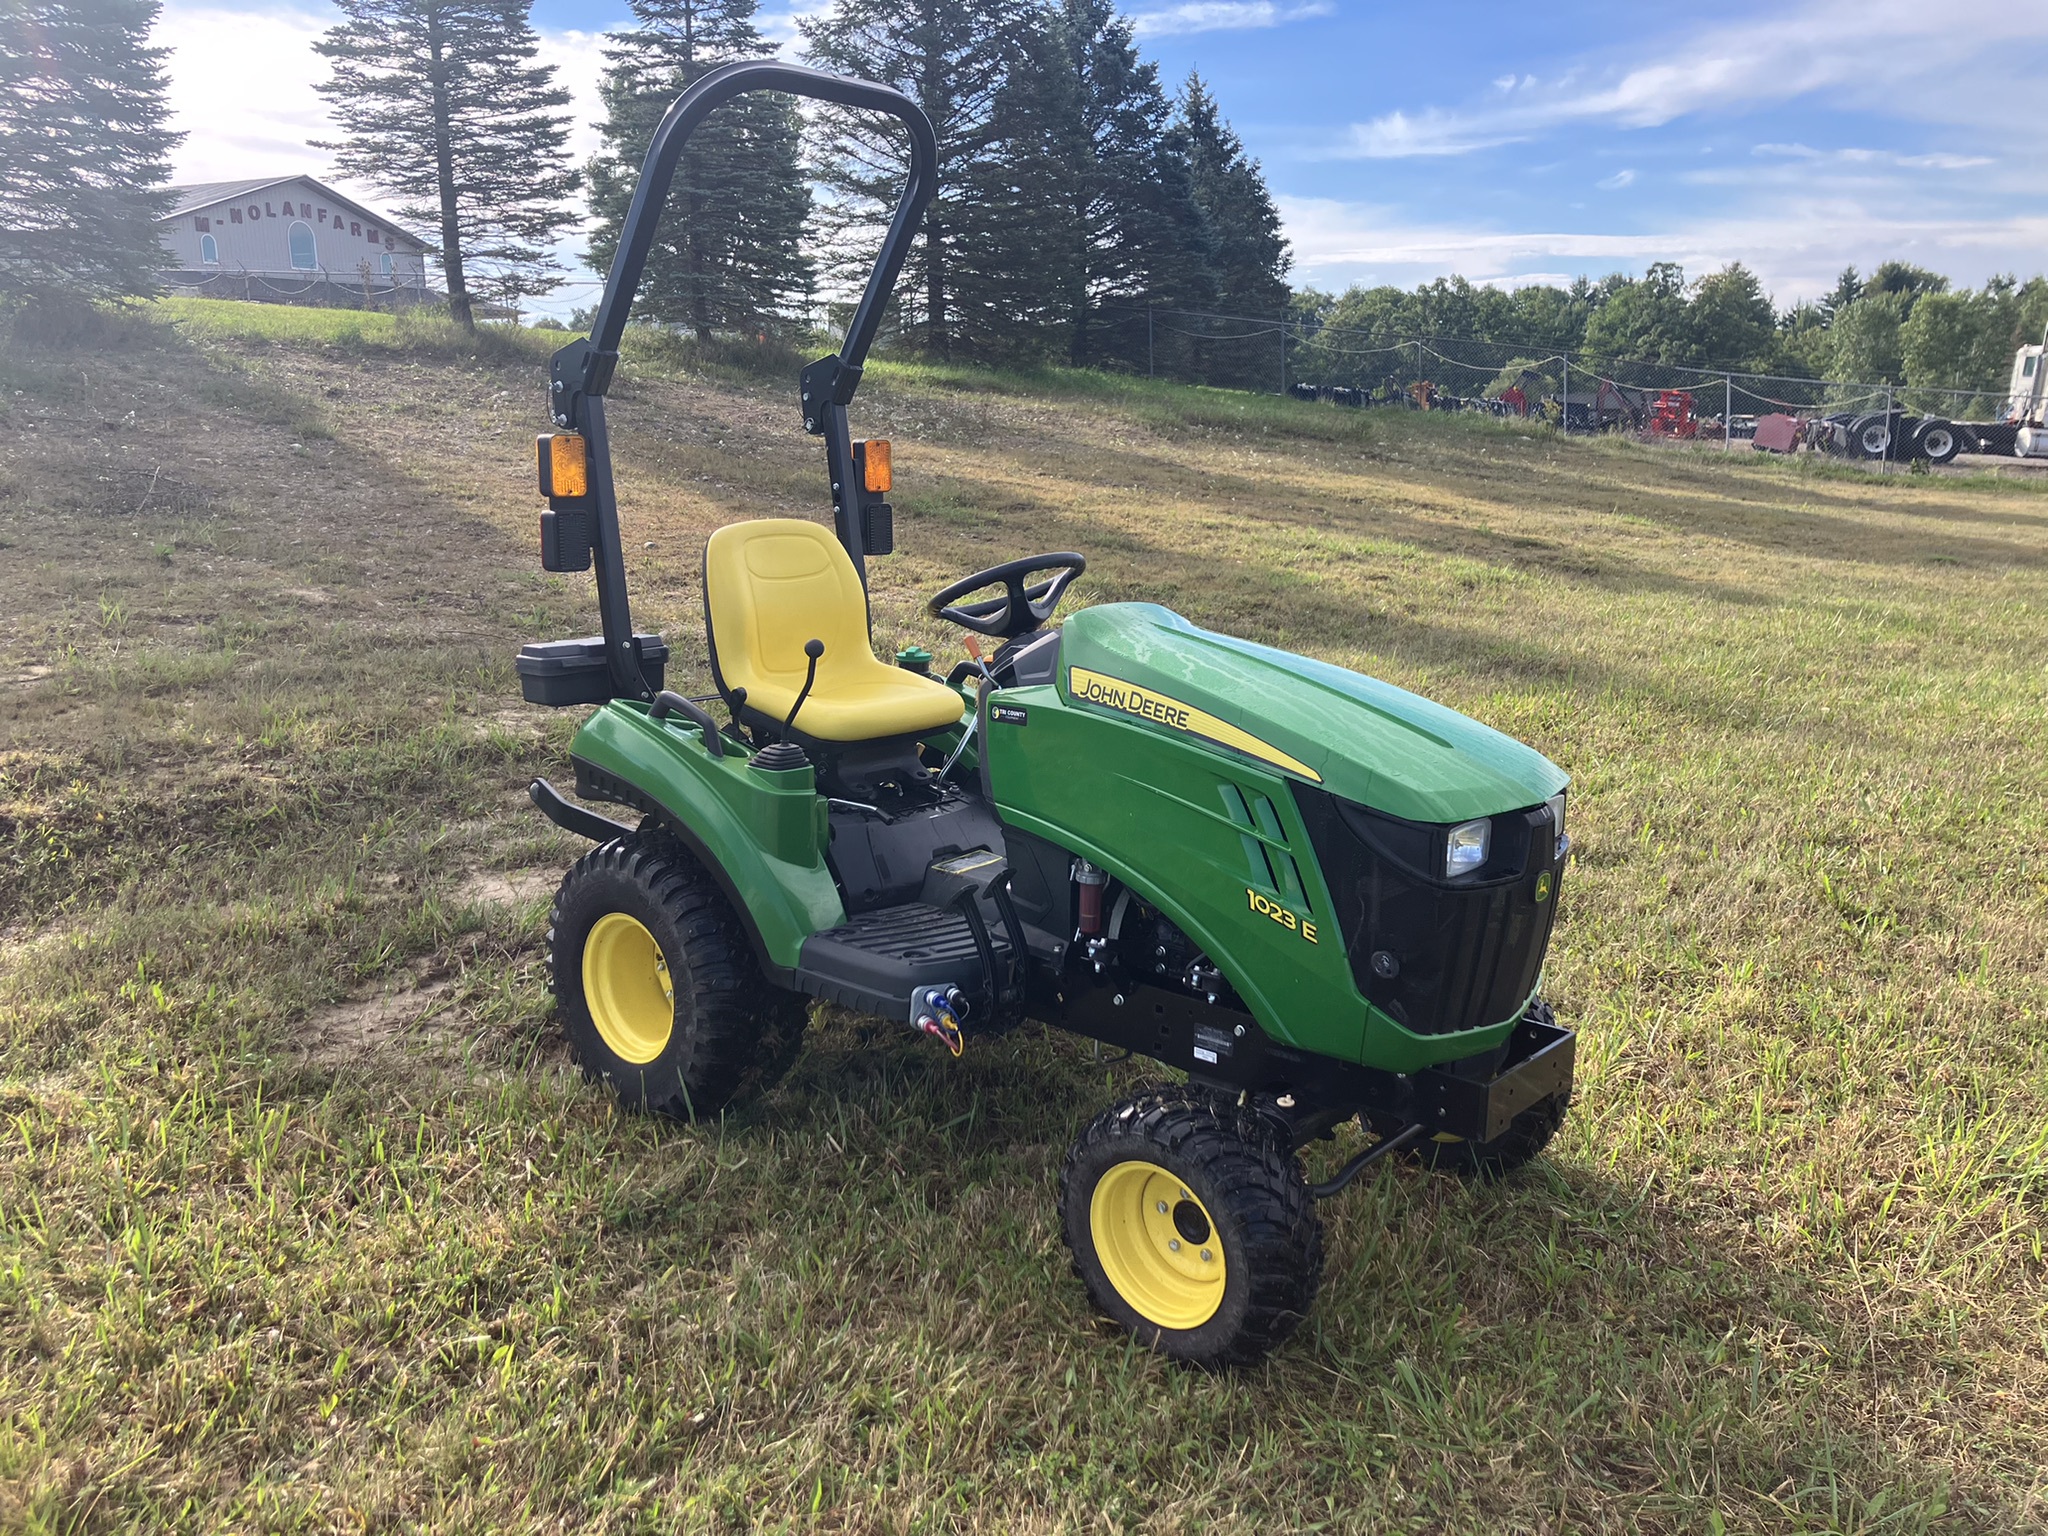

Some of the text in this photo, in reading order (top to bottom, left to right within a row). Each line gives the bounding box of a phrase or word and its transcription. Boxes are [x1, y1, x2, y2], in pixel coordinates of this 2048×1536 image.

[1007, 710, 1026, 719] COUNTY
[1080, 678, 1190, 728] JOHN DEERE
[1246, 887, 1319, 945] 1023 E
